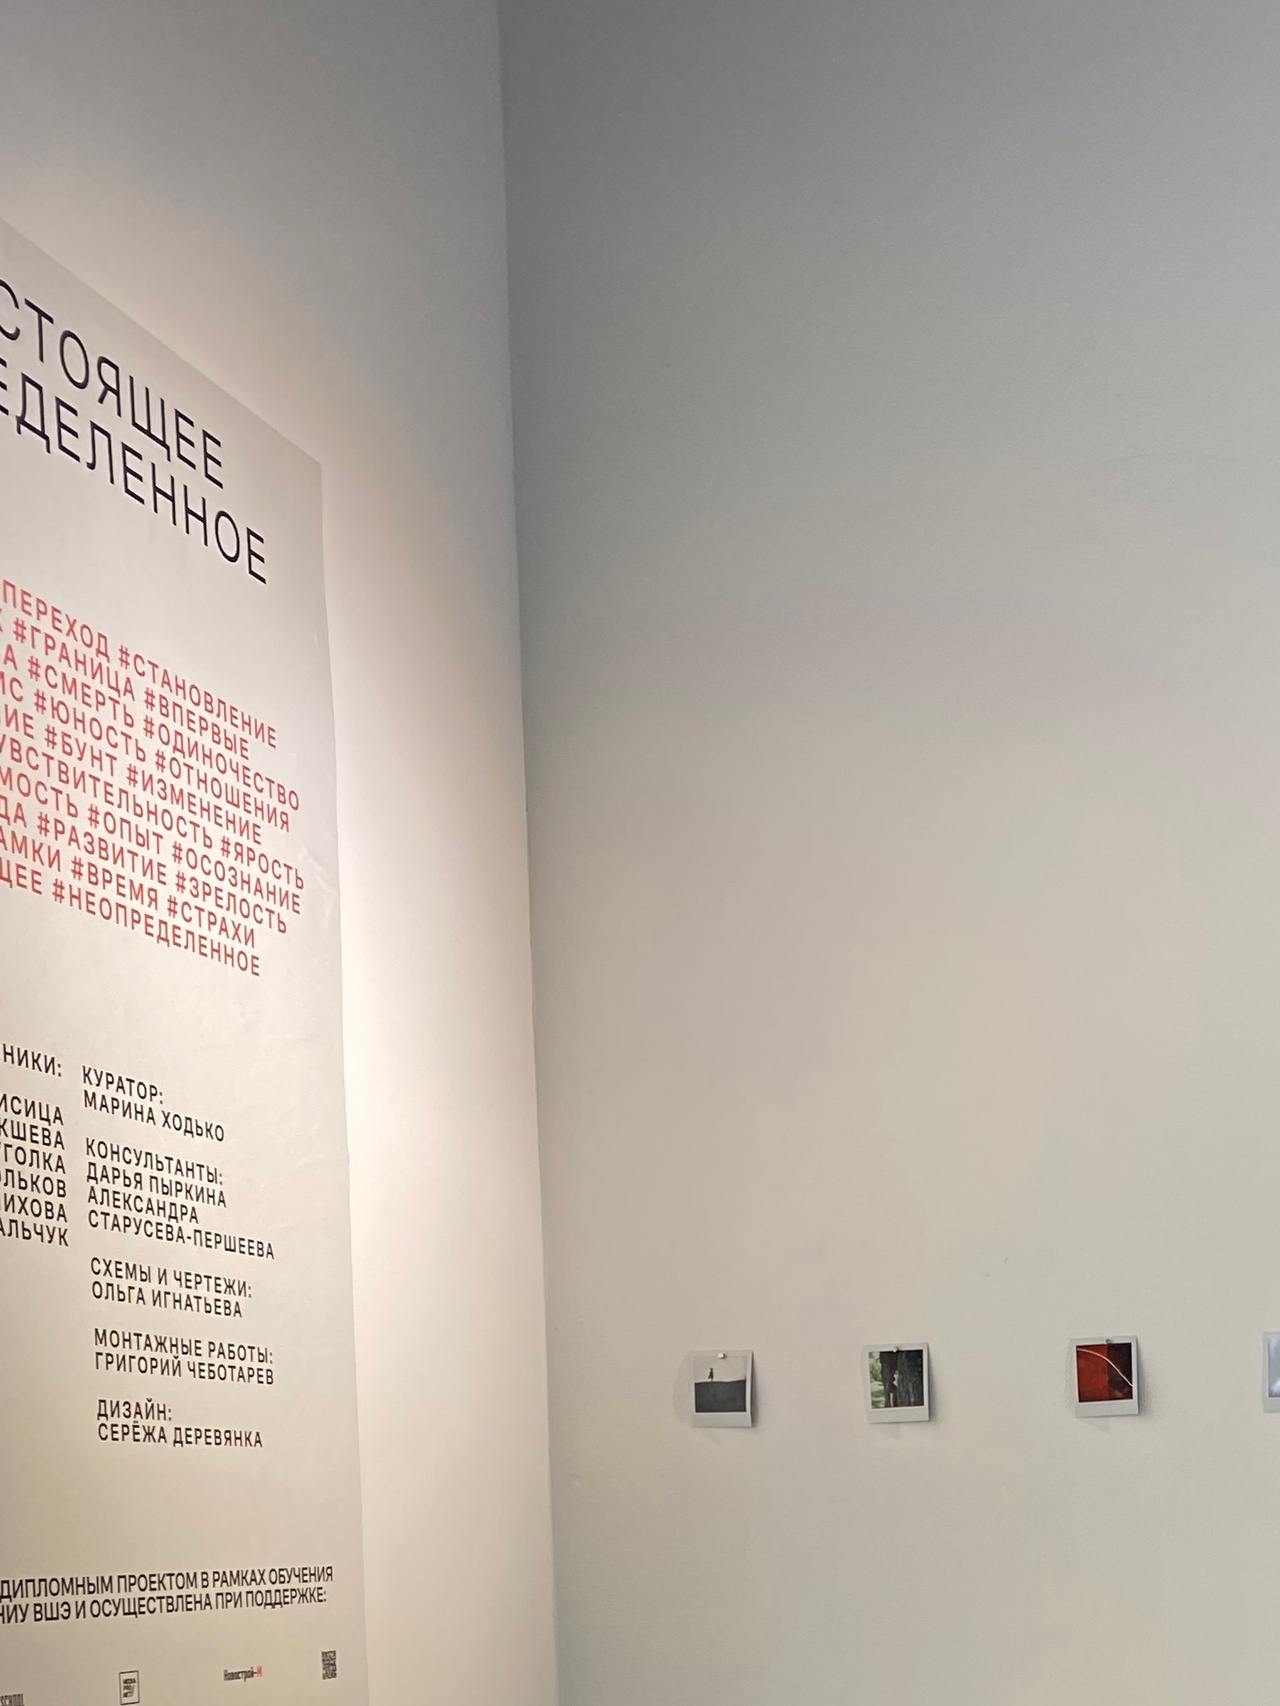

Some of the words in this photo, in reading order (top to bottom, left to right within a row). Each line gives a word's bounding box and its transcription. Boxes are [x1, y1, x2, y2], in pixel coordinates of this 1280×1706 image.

[3, 579, 110, 663] ПЕРЕХОД
[118, 645, 276, 749] #СТАНОВЛЕНИЕ
[13, 617, 135, 702] #ГРАНИЦА
[144, 687, 249, 761] #ВПЕРВЫЕ
[28, 656, 134, 728] #СМЕРТЬ
[143, 715, 299, 811] #ОДИНОЧЕСТВО
[34, 689, 146, 762] #ЮНОСТЬ
[155, 749, 289, 832] #ОТНОШЕНИЯ
[44, 724, 117, 777] #БУНТ
[126, 763, 262, 845] #ИЗМЕНЕНИЕ
[37, 811, 167, 886] #РАЗВИТИЕ
[176, 871, 286, 934] #ЗРЕЛОСТЬ
[88, 803, 163, 855] #ОПЫТ
[172, 841, 300, 914] #ОСОЗНАНИЕ
[221, 835, 304, 890] #ЯРОСТЬ
[71, 856, 158, 911] #ВРЕМЯ
[167, 895, 255, 948] #СТРАХИ
[52, 878, 260, 977] #НЕОПРЕДЕЛЕННОЕ
[82, 1065, 163, 1104] КУРАТОР:
[84, 1089, 155, 1126] МАРИНА
[162, 1110, 225, 1143] ХОДЬКО
[86, 1137, 223, 1185] КОНСУЛЬТАНТЫ:
[87, 1161, 143, 1190] ДАРЬЯ
[149, 1174, 227, 1208] ПЫРКИНА
[88, 1185, 199, 1224] АЛЕКСАНДРА
[88, 1209, 275, 1260] СТАРУСЕВА-ПЕРШЕЕВА
[91, 1257, 151, 1284] СХЕМЫ
[158, 1267, 168, 1286] И
[174, 1270, 252, 1298] ЧЕРТЕЖИ:
[91, 1281, 145, 1306] ОЛЬГА
[152, 1289, 242, 1318] ИГНАТЬЕВА
[94, 1328, 202, 1357] МОНТАЖНЫЕ
[208, 1341, 273, 1364] РАБОТЫ:
[95, 1351, 182, 1378] ГРИГОРИЙ
[187, 1361, 274, 1385] ЧЕБОТАРЕВ
[97, 1398, 172, 1422] ДИЗАЙН:
[98, 1420, 167, 1444] СЕРЁЖА
[173, 1427, 262, 1448] ДЕРЕВЯНКА
[0, 1575, 113, 1602] ДИПЛОМНЫМ
[117, 1571, 198, 1594] ПРОЕКТОМ
[201, 1571, 209, 1589] В
[212, 1568, 266, 1588] РАМКАХ
[268, 1566, 333, 1585] ОБУЧЕНИЯ
[33, 1601, 71, 1622] ВШЭ
[75, 1600, 86, 1619] И
[90, 1593, 213, 1618] ОСУЩЕСТВЛЕНА
[215, 1591, 242, 1610] ПРИ
[246, 1586, 327, 1609] ПОДДЕРЖКЕ:
